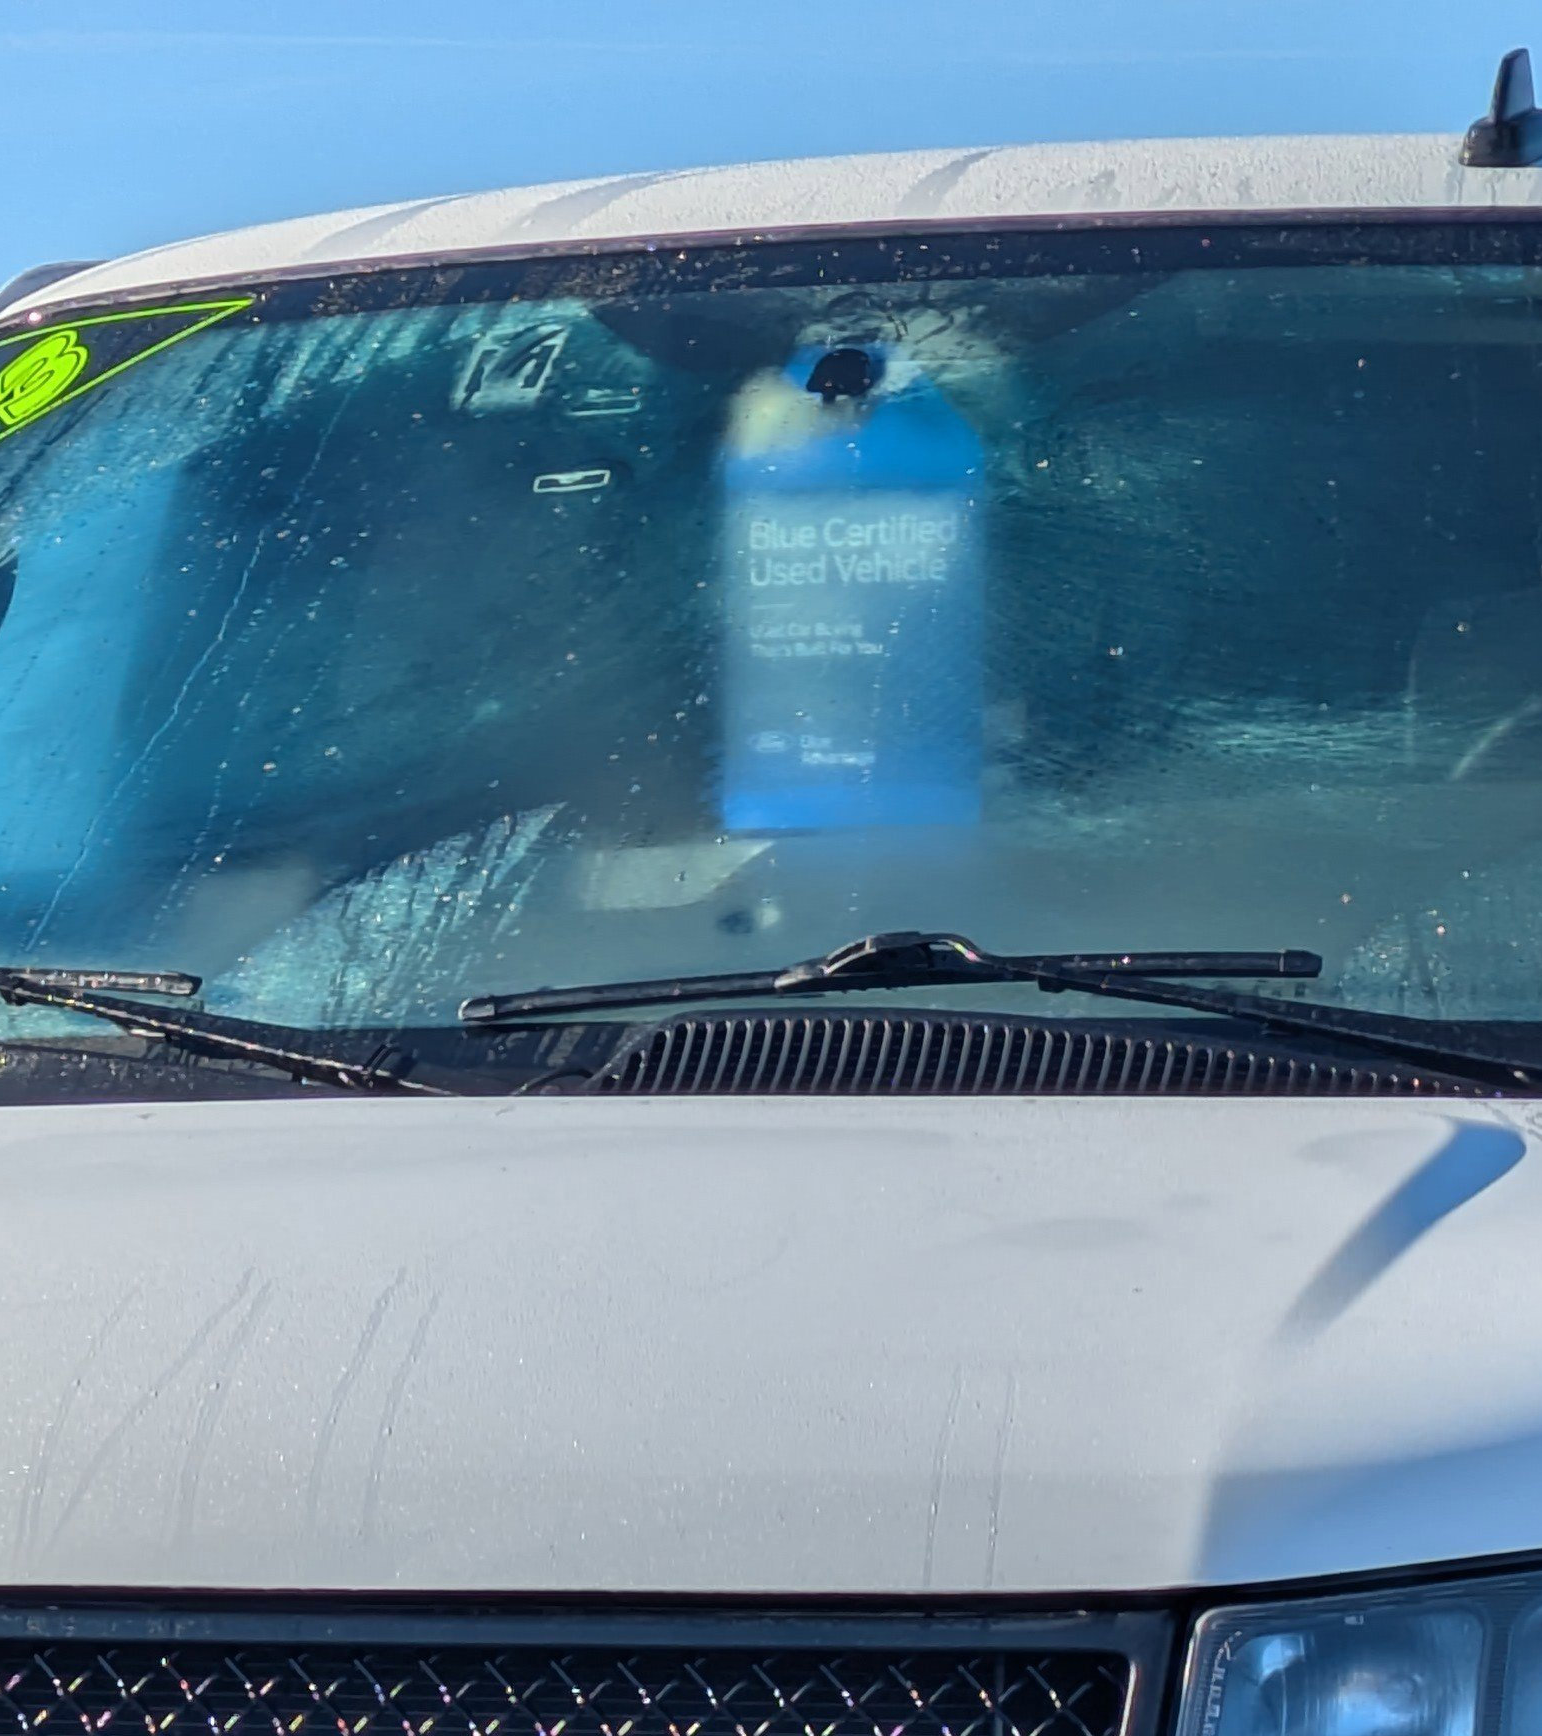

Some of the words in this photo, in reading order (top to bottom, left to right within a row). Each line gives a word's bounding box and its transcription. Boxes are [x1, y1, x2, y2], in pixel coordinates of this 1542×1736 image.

[749, 519, 817, 550] Blue
[823, 514, 957, 547] Certified
[750, 555, 827, 586] Used
[833, 551, 948, 584] Vehicle
